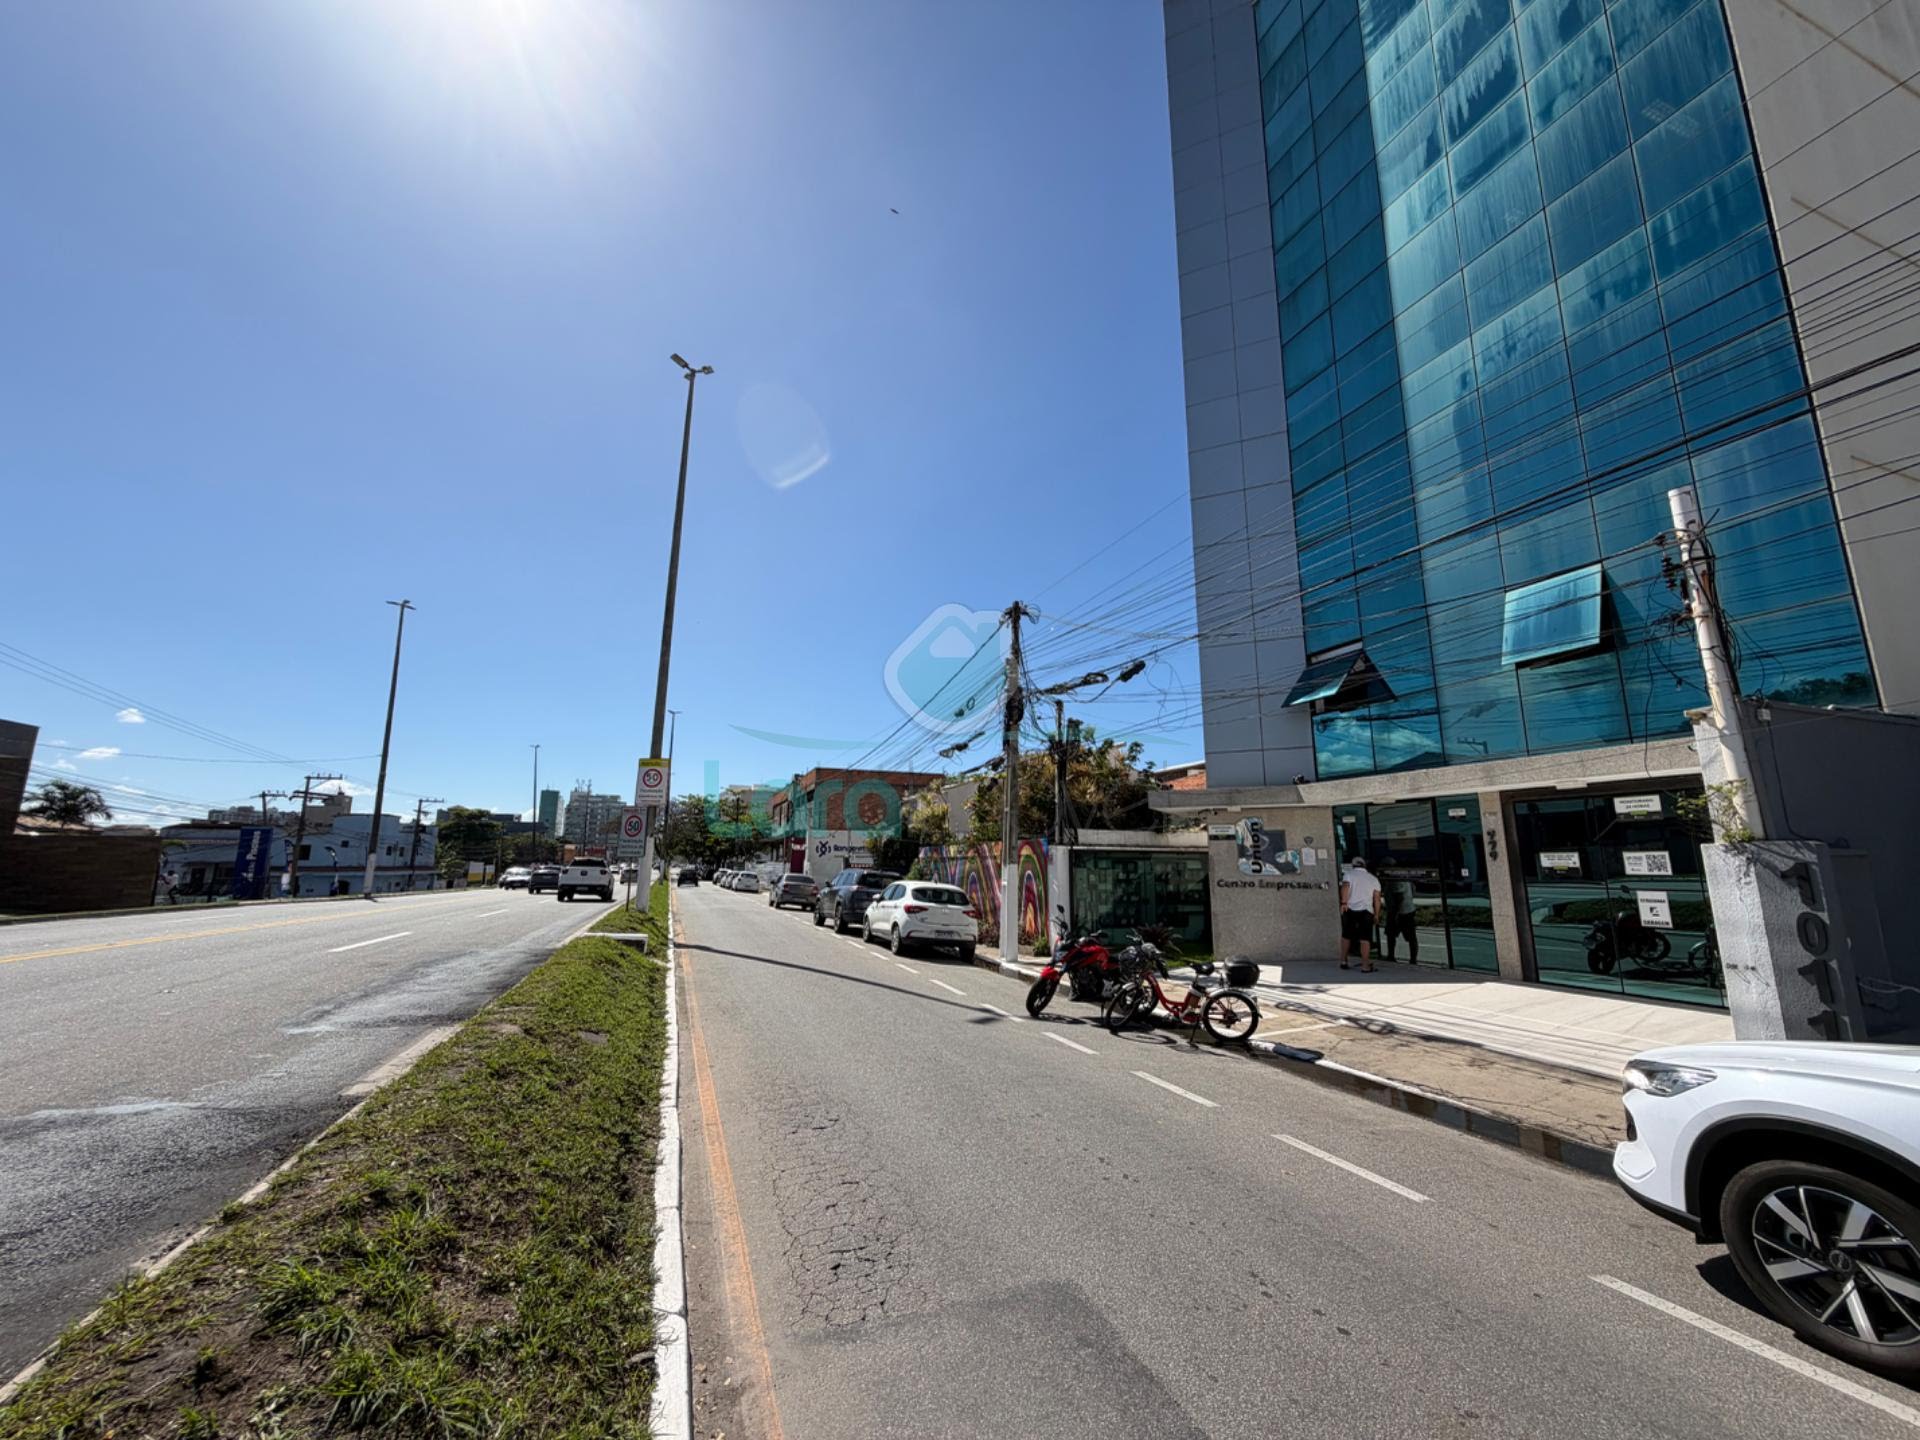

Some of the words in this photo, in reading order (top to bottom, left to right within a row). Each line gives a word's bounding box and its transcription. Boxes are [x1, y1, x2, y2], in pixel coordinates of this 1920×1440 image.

[646, 772, 659, 784] 50
[627, 820, 640, 832] 50
[1251, 822, 1263, 874] Union
[1217, 879, 1255, 889] Centro
